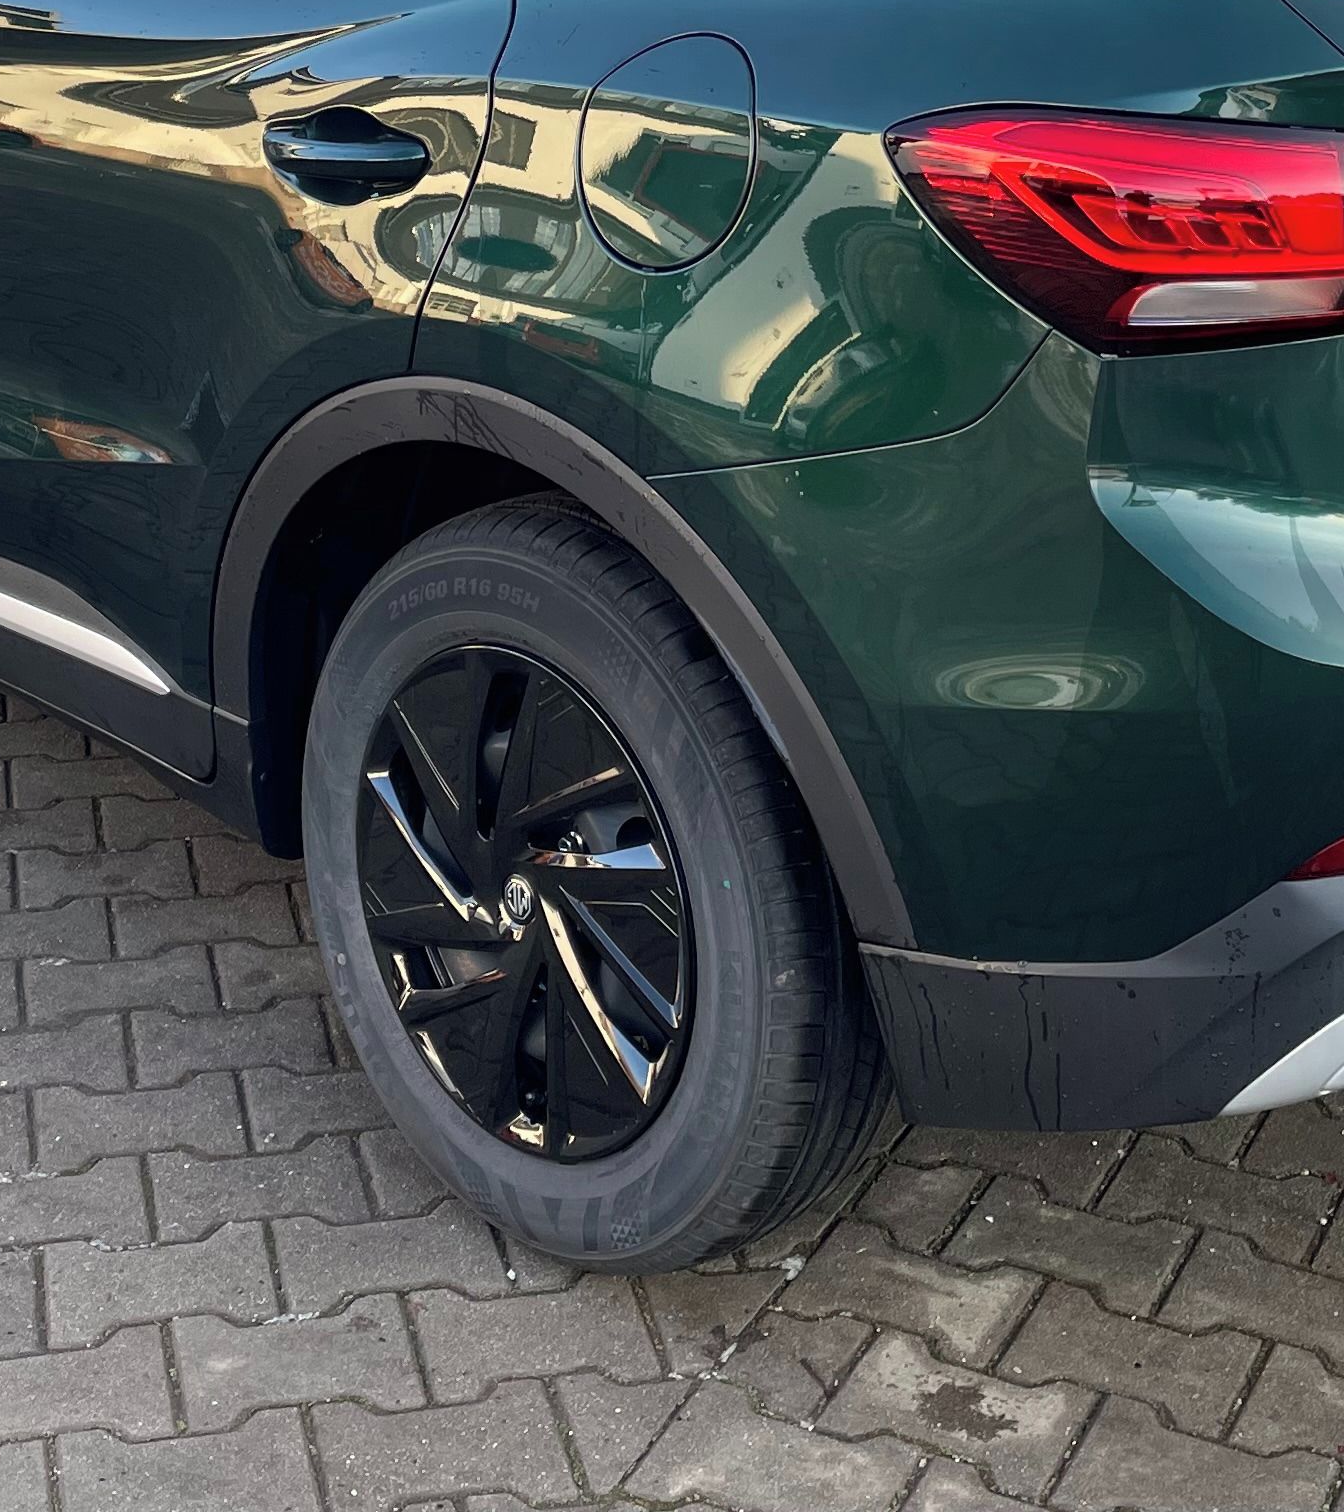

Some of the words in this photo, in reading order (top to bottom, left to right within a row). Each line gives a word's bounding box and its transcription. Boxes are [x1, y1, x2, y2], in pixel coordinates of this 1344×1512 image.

[387, 579, 448, 622] 215/60
[453, 577, 492, 597] R16
[497, 583, 541, 614] 95H
